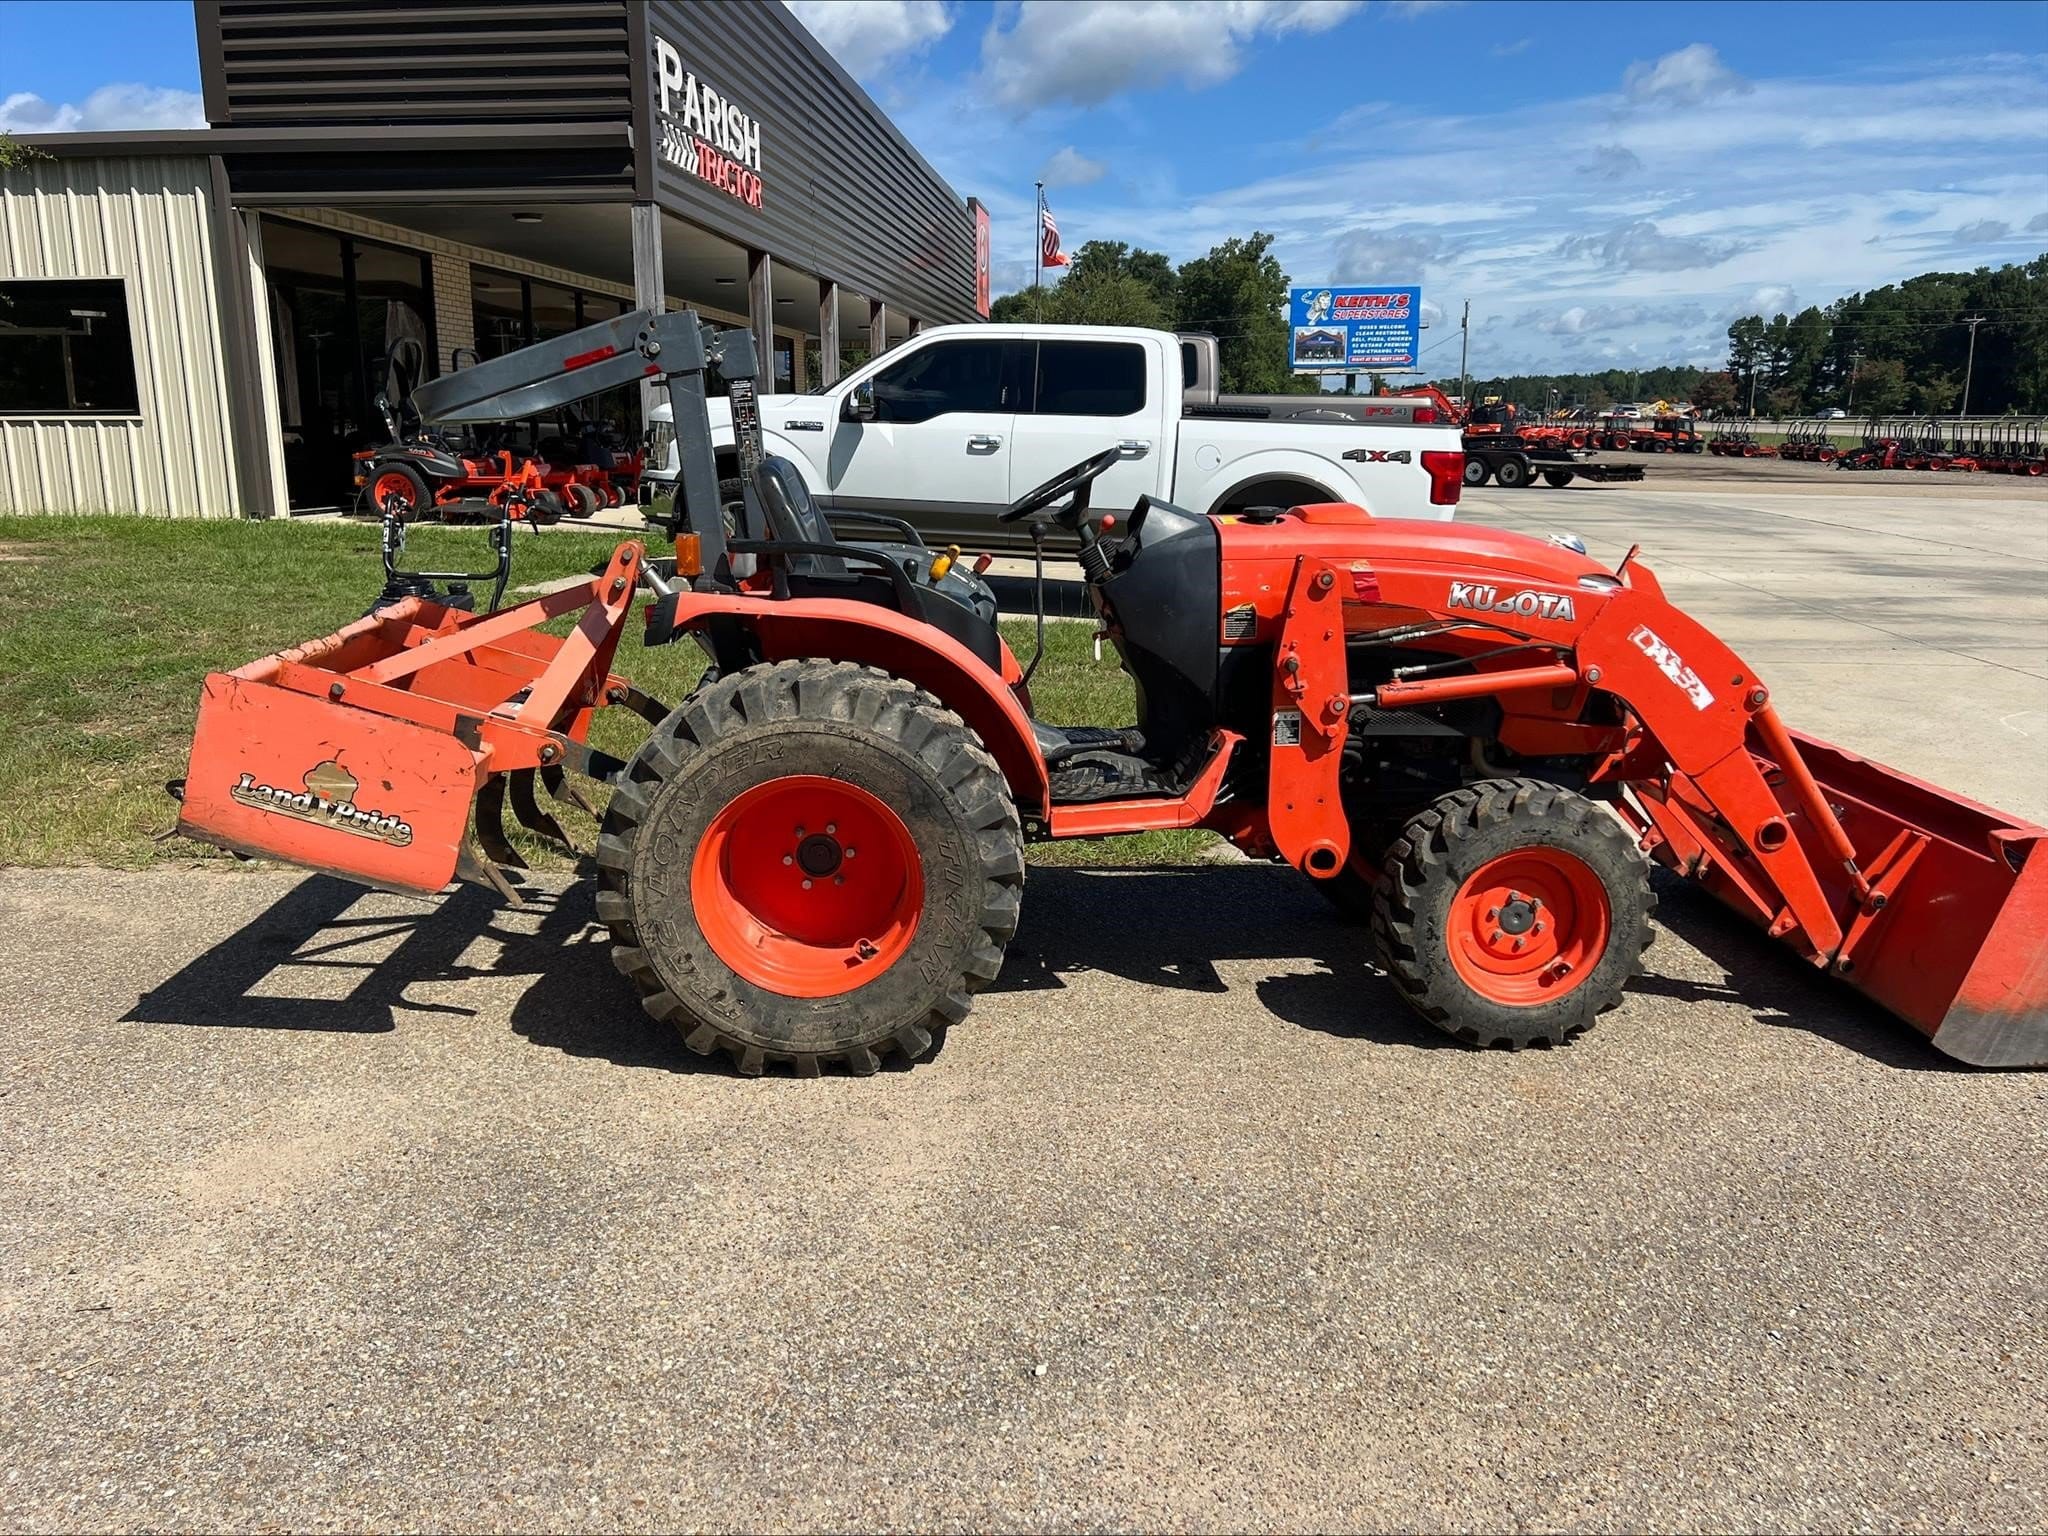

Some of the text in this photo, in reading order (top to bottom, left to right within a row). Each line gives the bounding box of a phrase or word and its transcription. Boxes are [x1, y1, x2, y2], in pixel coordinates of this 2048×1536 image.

[655, 36, 761, 172] PARISH
[694, 139, 763, 209] TRACTOR
[1333, 309, 1409, 320] SUPERSTORES
[1334, 294, 1410, 308] KEITH'S
[1365, 406, 1408, 417] FX4
[1449, 582, 1575, 621] KUBOTA
[235, 773, 412, 839] Land Pride
